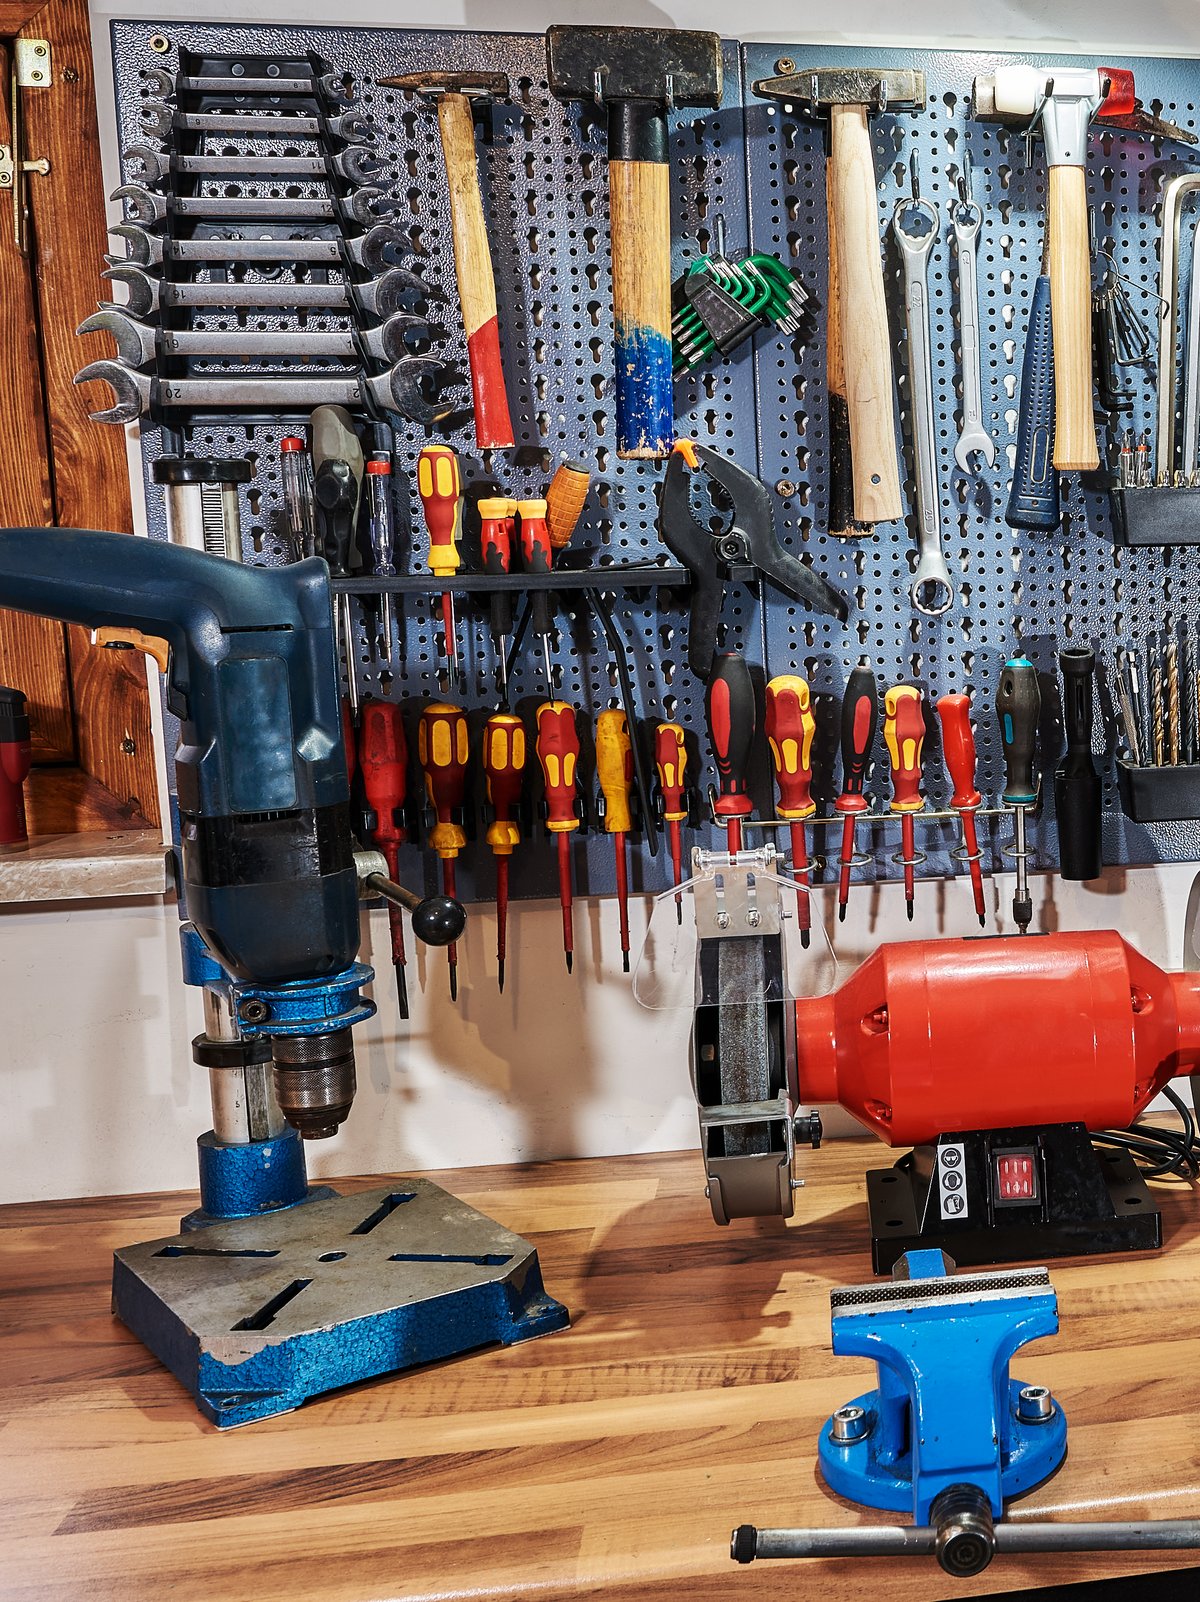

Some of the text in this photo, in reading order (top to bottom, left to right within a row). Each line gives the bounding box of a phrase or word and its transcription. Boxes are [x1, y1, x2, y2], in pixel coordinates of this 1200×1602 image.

[173, 246, 186, 254] 14
[173, 289, 186, 299] 16
[165, 339, 179, 349] 19
[165, 388, 182, 399] 20
